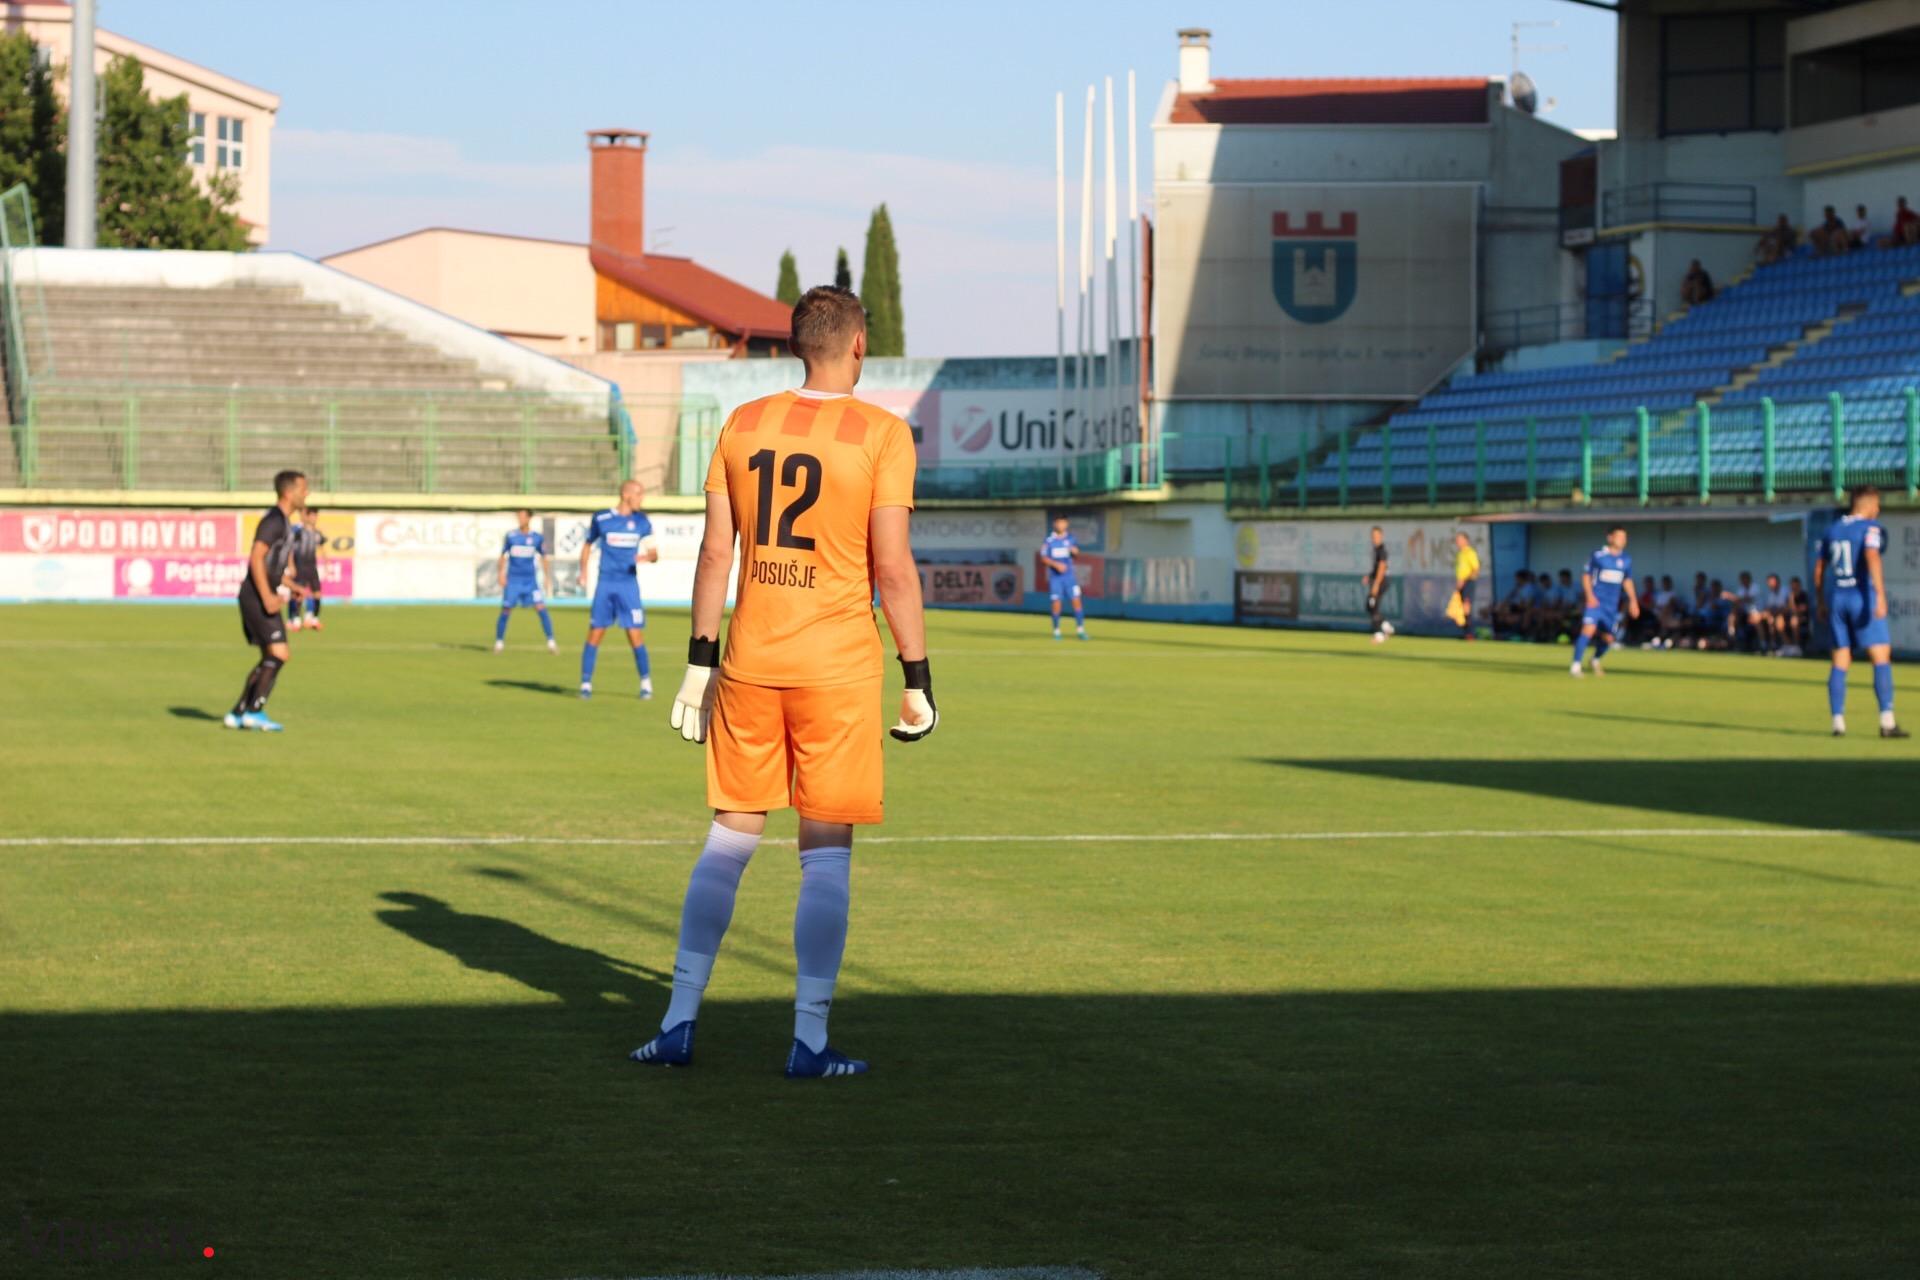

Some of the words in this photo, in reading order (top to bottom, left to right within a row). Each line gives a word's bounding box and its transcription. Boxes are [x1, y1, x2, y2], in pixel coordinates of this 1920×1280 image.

[748, 448, 822, 552] 12
[59, 519, 217, 549] PODRAVKA
[1831, 541, 1853, 576] 21
[751, 559, 816, 589] POSUŠJE
[934, 571, 984, 589] DELTA
